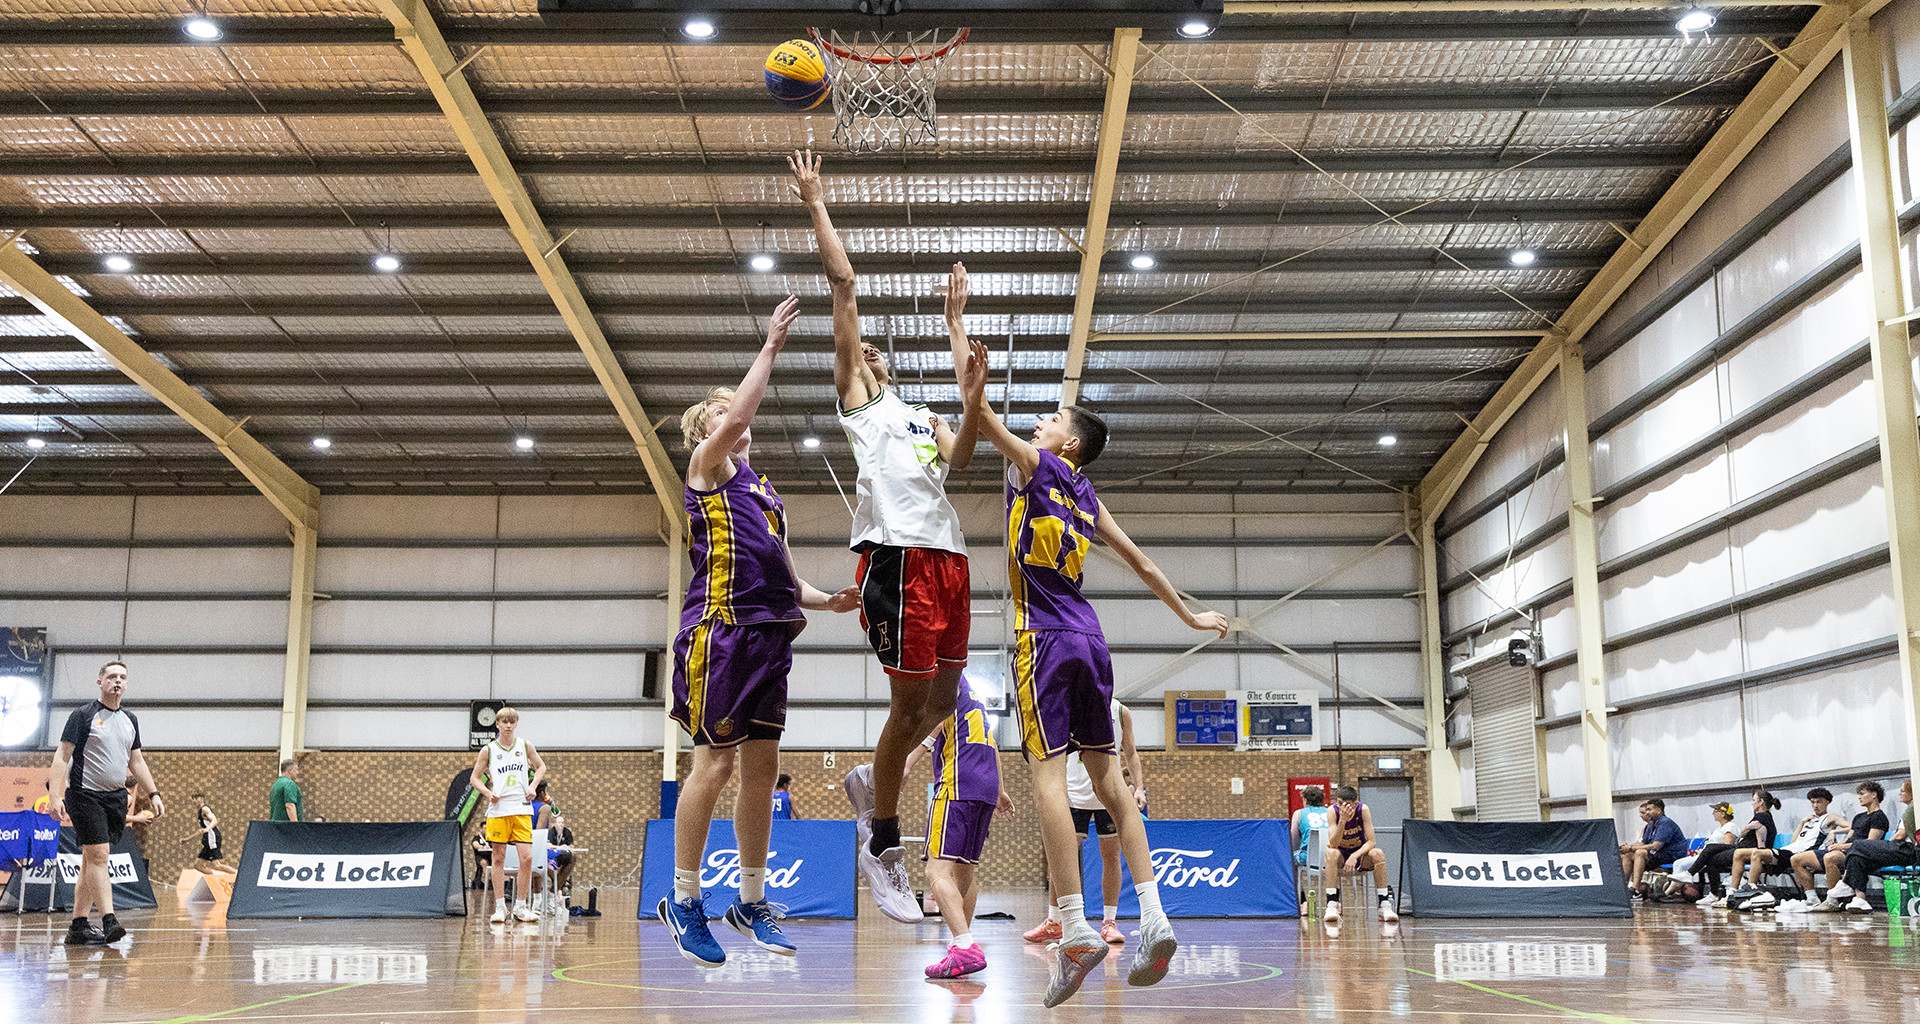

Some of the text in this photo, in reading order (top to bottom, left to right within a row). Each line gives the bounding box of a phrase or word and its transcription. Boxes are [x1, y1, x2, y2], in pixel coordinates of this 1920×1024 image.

[1246, 690, 1297, 701] The Courier
[964, 708, 995, 748] 1
[1248, 737, 1298, 747] The Courier
[825, 757, 833, 767] 6
[506, 774, 517, 787] 6
[60, 858, 81, 878] Foo
[107, 859, 132, 878] cker
[266, 859, 425, 882] Foot Locker
[1150, 847, 1240, 888] Ford
[1436, 858, 1593, 881] Foot Locker
